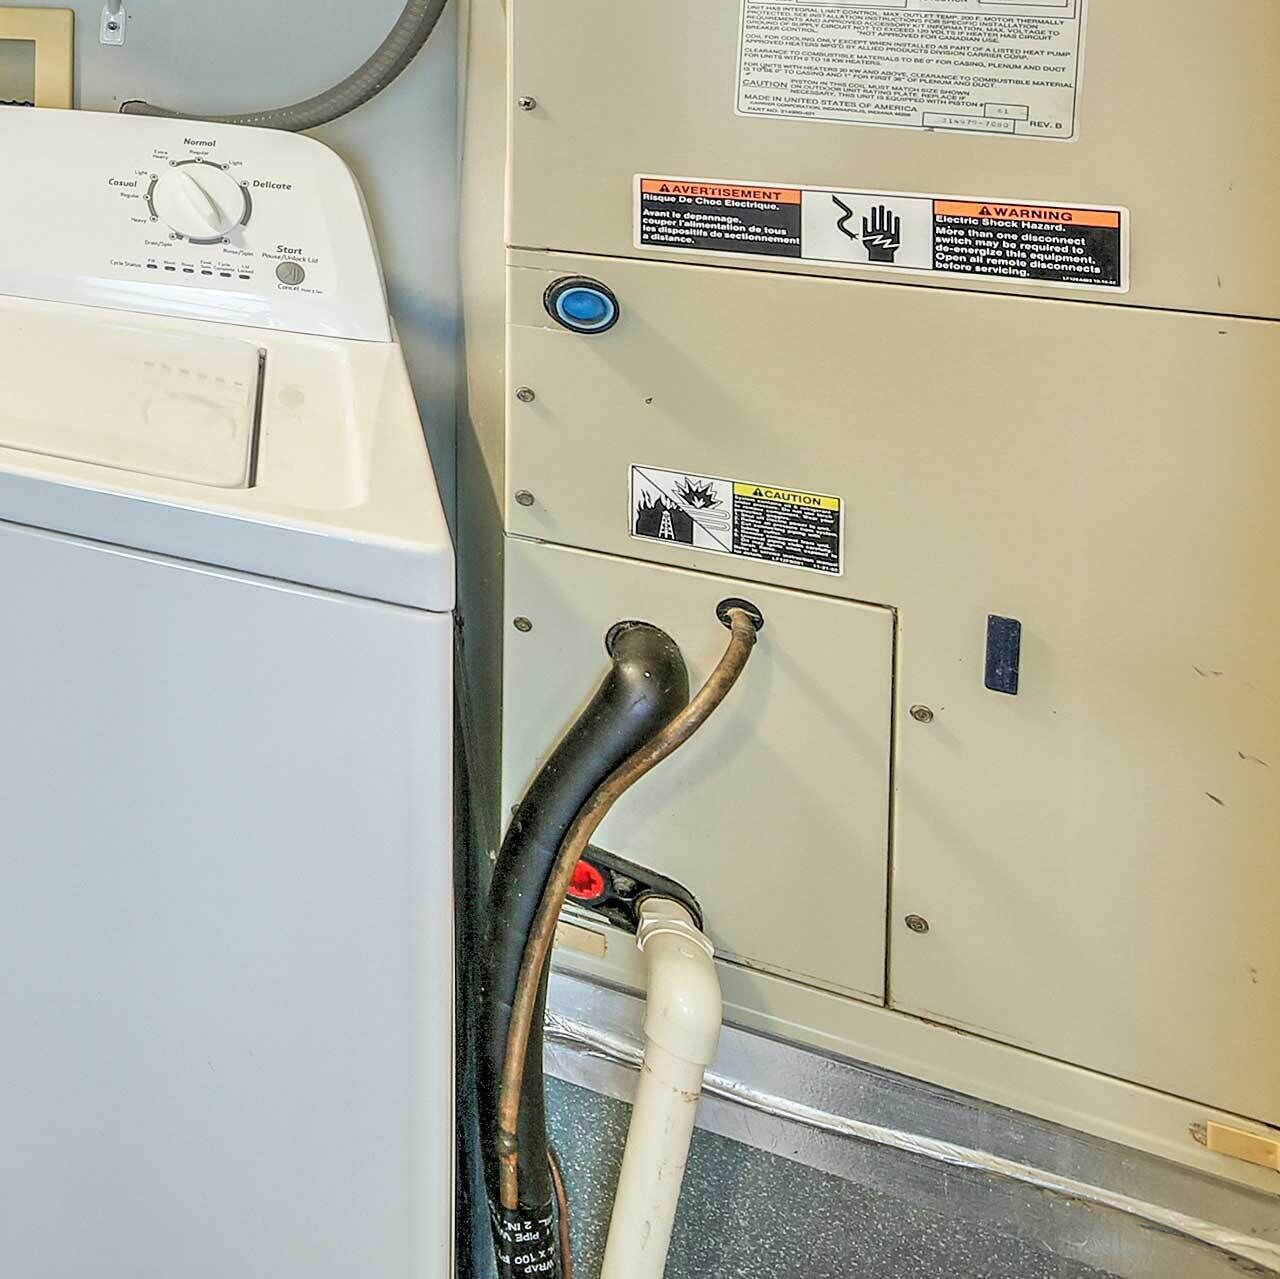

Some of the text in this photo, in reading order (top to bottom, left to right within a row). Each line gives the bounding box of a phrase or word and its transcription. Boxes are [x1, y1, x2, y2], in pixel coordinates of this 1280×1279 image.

[743, 79, 788, 88] CAUTION
[821, 100, 856, 108] STATES
[874, 104, 917, 112] AMERICA
[184, 138, 216, 147] Normal
[108, 178, 137, 187] Casual
[253, 180, 292, 190] Delicate
[673, 185, 782, 200] AVERTISEMENT
[643, 194, 676, 204] Risque
[695, 198, 722, 206] Choc
[725, 200, 779, 211] Electrique.
[643, 209, 670, 217] Avant
[994, 208, 1072, 221] WARNING
[643, 219, 676, 227] couper
[679, 220, 746, 231] l'alimentation
[764, 227, 787, 235] tous
[936, 215, 1066, 231] Electric Shock Hazard.
[651, 233, 695, 244] distance.
[658, 226, 708, 237] dispositifs
[710, 230, 723, 238] de
[724, 232, 799, 245] sectionnement
[936, 227, 965, 236] More
[968, 229, 993, 238] than
[1021, 233, 1085, 245] disconnect
[277, 245, 302, 255] Start
[936, 236, 1083, 254] switch may be required to
[262, 252, 306, 263] Pause/Unlock
[936, 245, 1095, 264] de-energize this equipment.
[936, 253, 1101, 274] Open all remote disconnects
[936, 261, 1030, 277] before servicing.
[278, 283, 299, 292] Cancel
[764, 490, 821, 505] CAUTION
[524, 1221, 531, 1229] 2
[515, 1232, 539, 1242] PIPE
[515, 1253, 536, 1264] 100
[524, 1260, 554, 1273] WRAP
